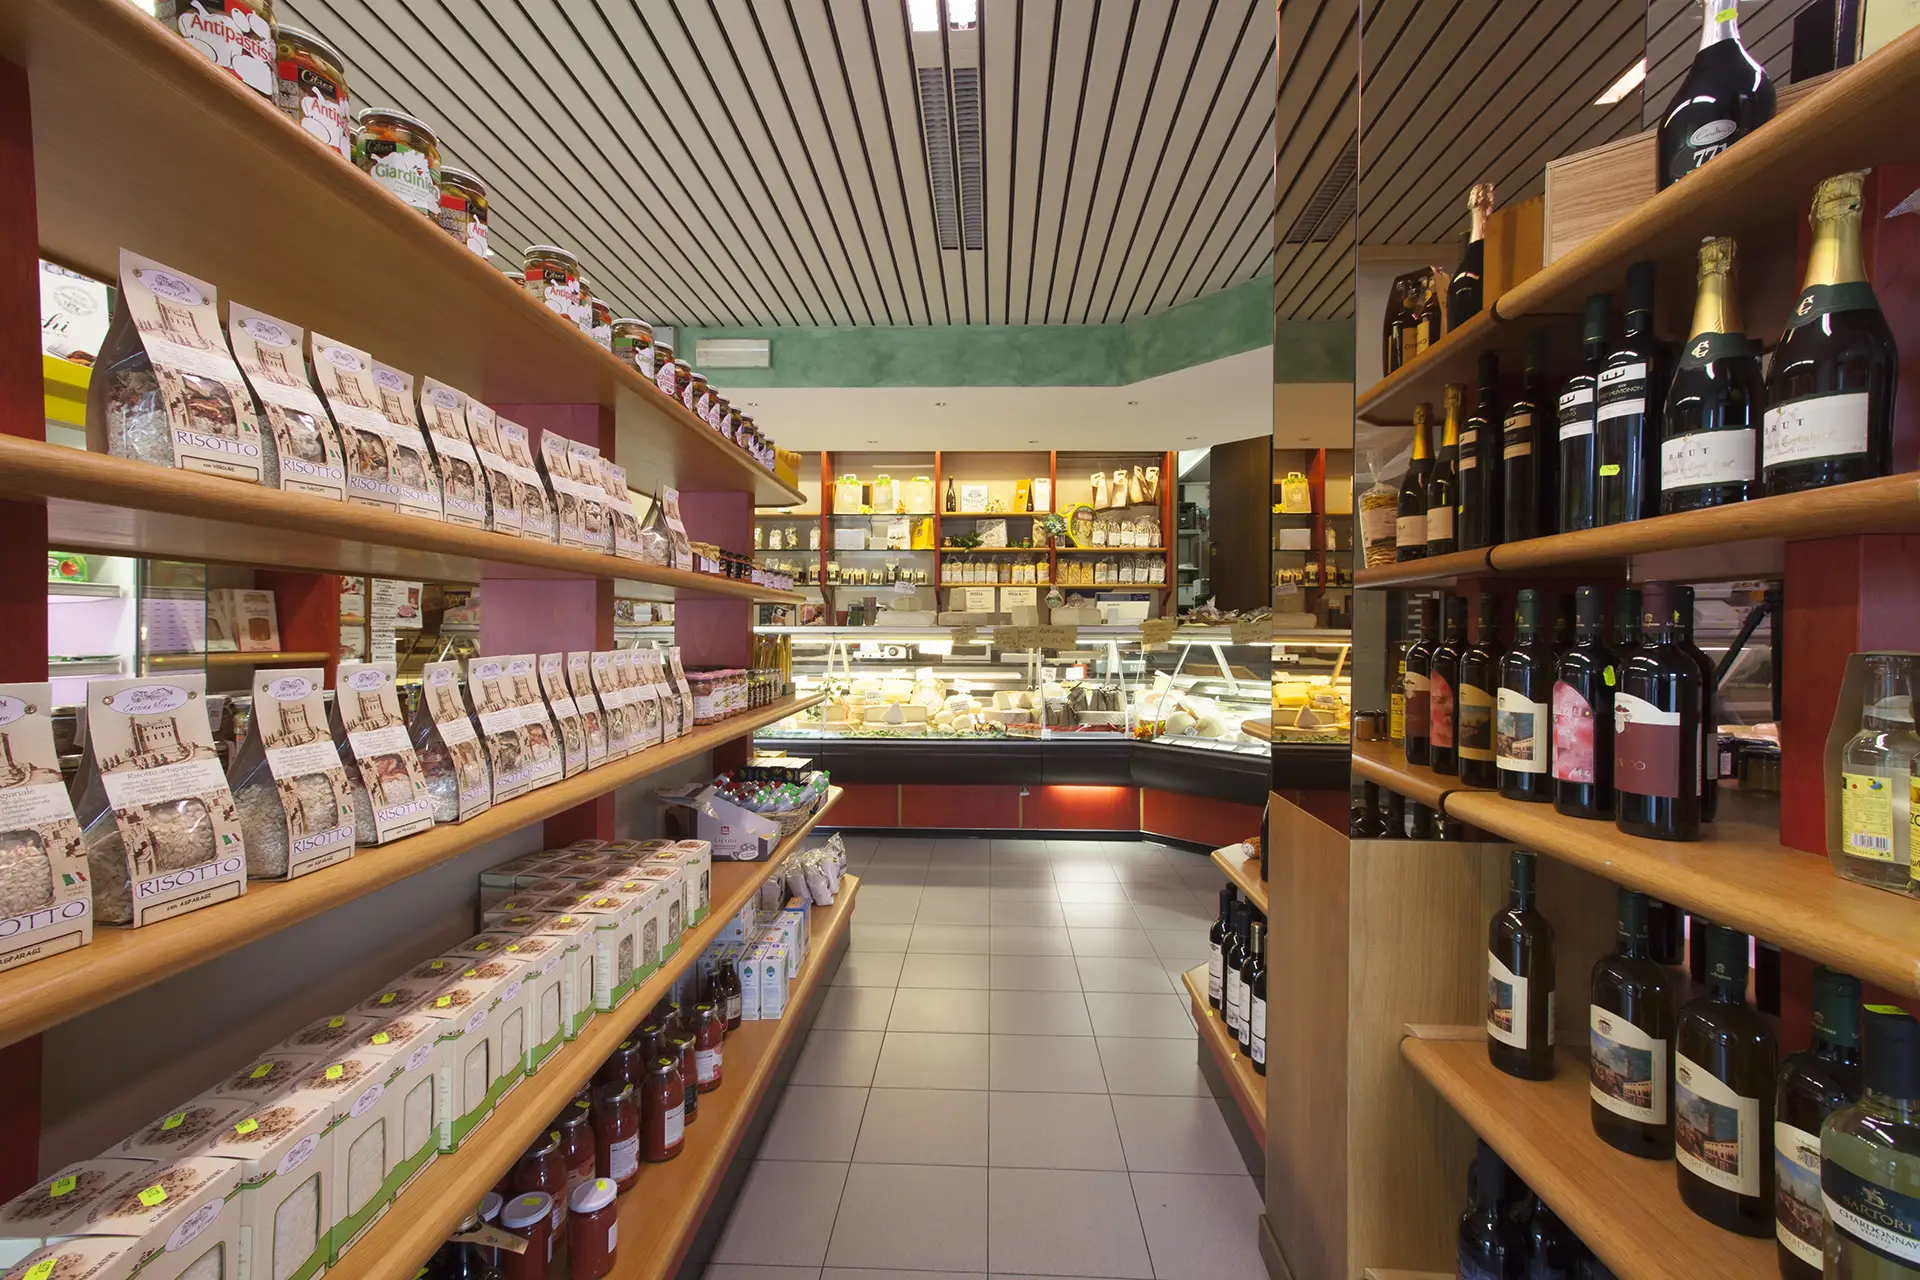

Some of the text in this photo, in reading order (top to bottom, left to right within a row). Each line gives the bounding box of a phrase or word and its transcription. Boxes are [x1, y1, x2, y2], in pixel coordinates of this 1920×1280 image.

[176, 430, 259, 457] RISOTTO
[1668, 446, 1710, 461] BRUT
[282, 459, 343, 480] RISOTTO
[350, 476, 399, 495] RISOTTO
[378, 800, 429, 822] RISOTTO
[293, 826, 353, 855] RISOTTO
[138, 857, 241, 898] RISOTTO
[179, 892, 212, 908] ASPARAGI
[150, 1190, 191, 1223] CASCINA
[1842, 1195, 1912, 1233] SARTORI
[1839, 1208, 1919, 1250] CHARDONNAY
[1860, 1227, 1891, 1244] VENETO
